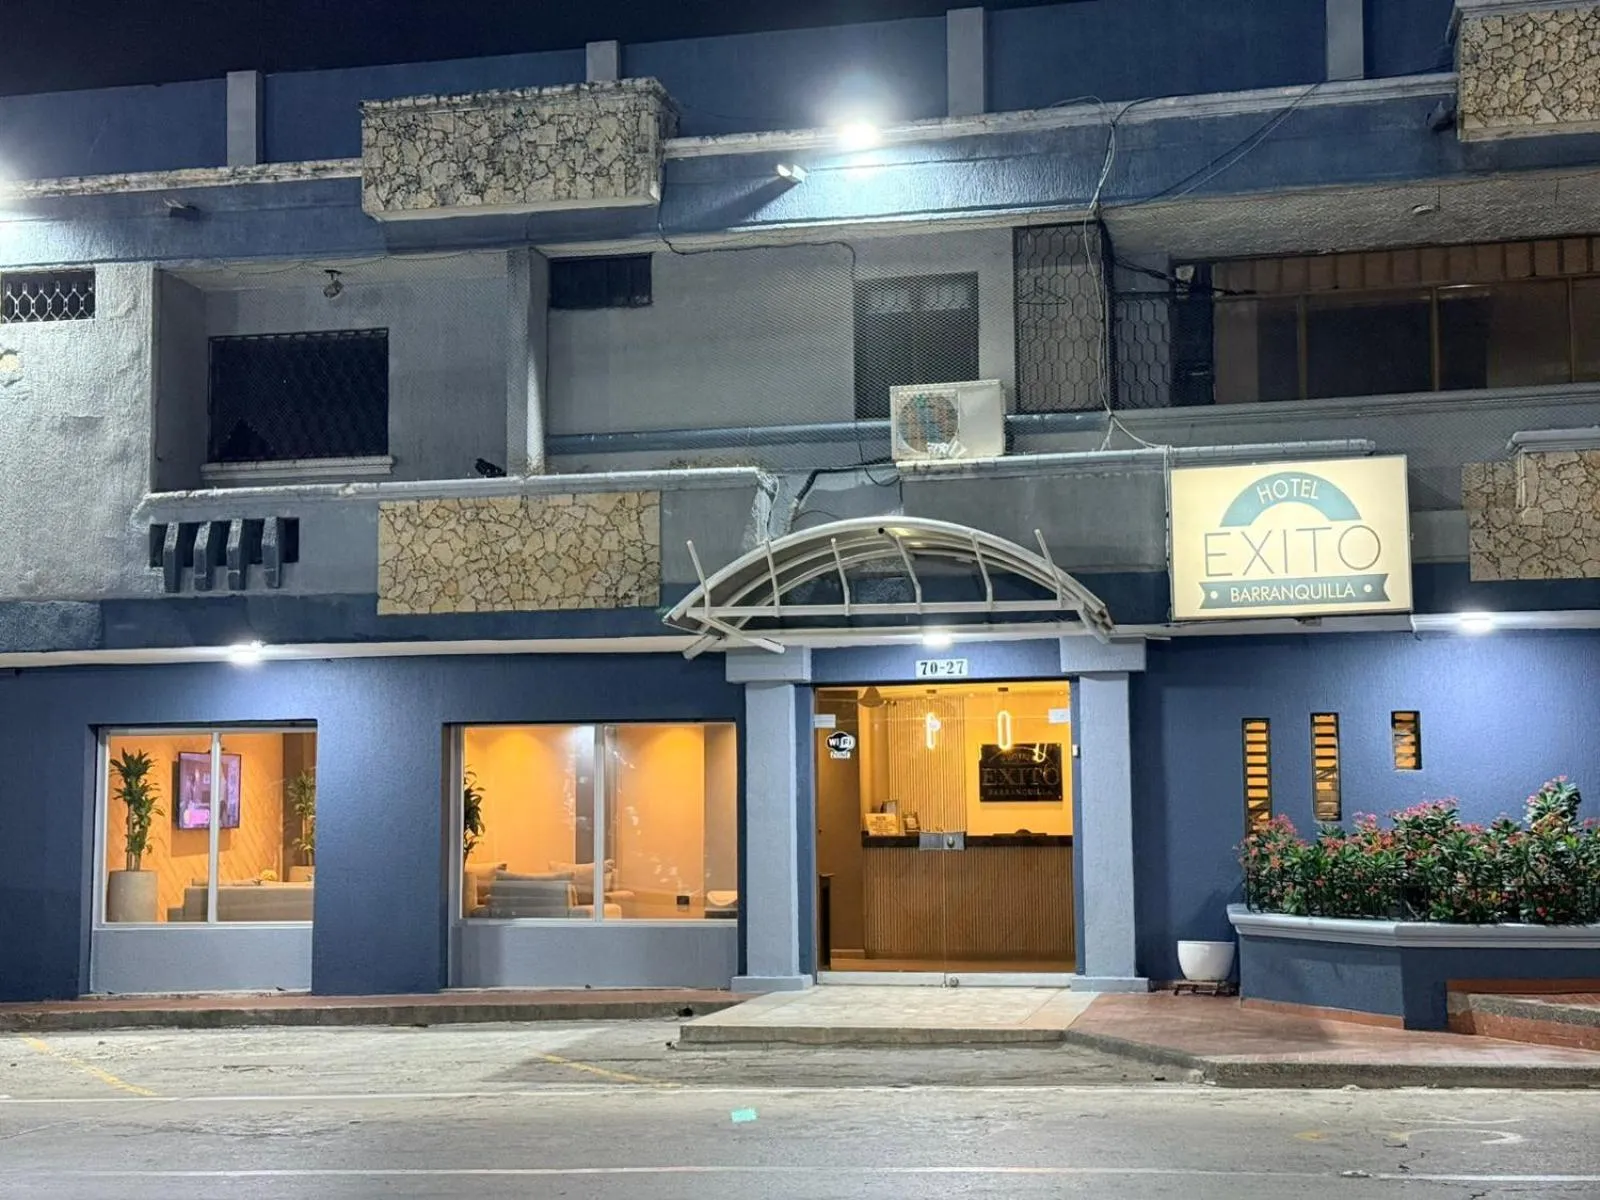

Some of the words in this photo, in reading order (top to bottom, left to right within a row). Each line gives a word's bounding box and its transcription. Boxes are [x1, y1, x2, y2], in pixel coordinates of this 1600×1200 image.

[1257, 478, 1319, 503] HOTEL
[1204, 525, 1381, 577] EXITO
[1230, 583, 1356, 603] BARRANQUILLA
[920, 661, 964, 675] 70-27
[982, 768, 1060, 786] EXITO
